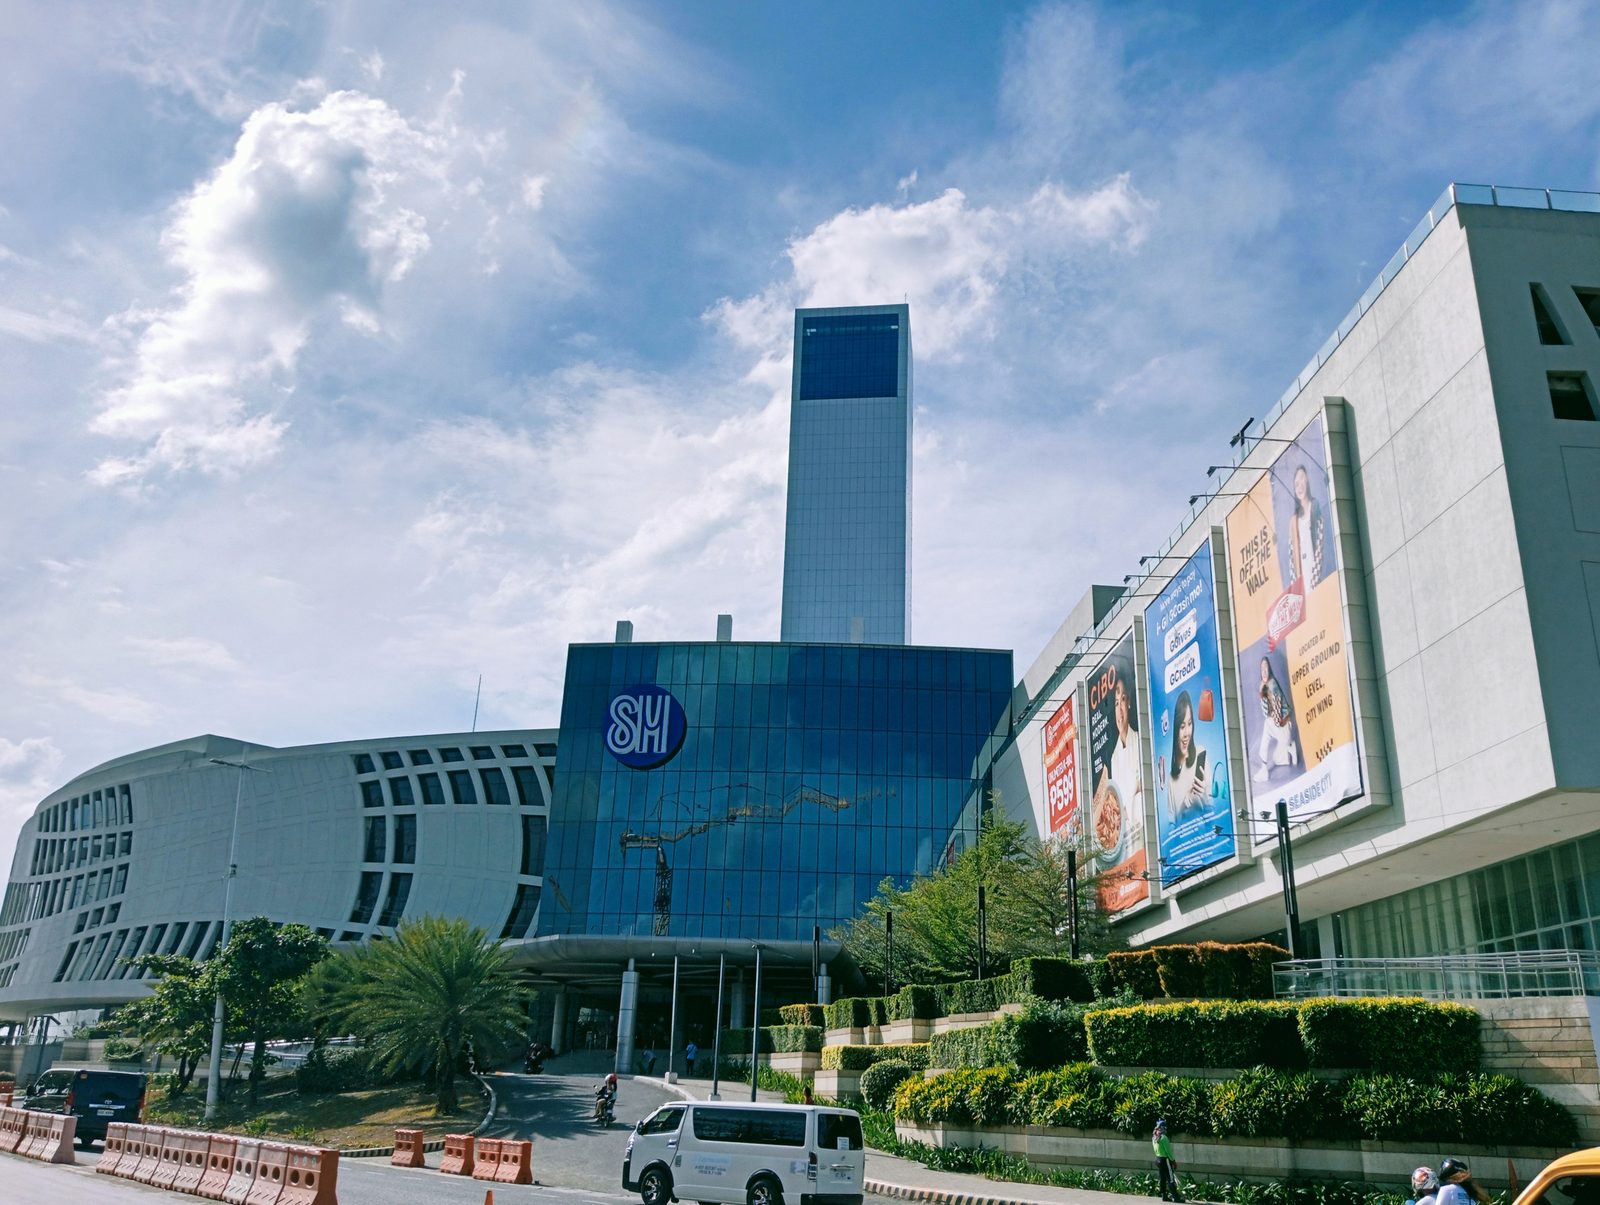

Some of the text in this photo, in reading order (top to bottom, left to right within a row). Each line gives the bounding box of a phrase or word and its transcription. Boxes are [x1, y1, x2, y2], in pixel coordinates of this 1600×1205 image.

[1240, 525, 1268, 564] THIS IS
[1187, 569, 1195, 586] pay
[1239, 541, 1271, 584] OFF THE
[1246, 566, 1269, 597] WALL
[1169, 593, 1190, 622] GCash
[1298, 629, 1326, 657] LOCATED AT
[1169, 657, 1196, 686] GCredit
[1292, 641, 1340, 686] UPPER GROUND
[1090, 664, 1116, 710] CIBO
[607, 694, 671, 755] SM
[1305, 694, 1333, 724] CITY WING
